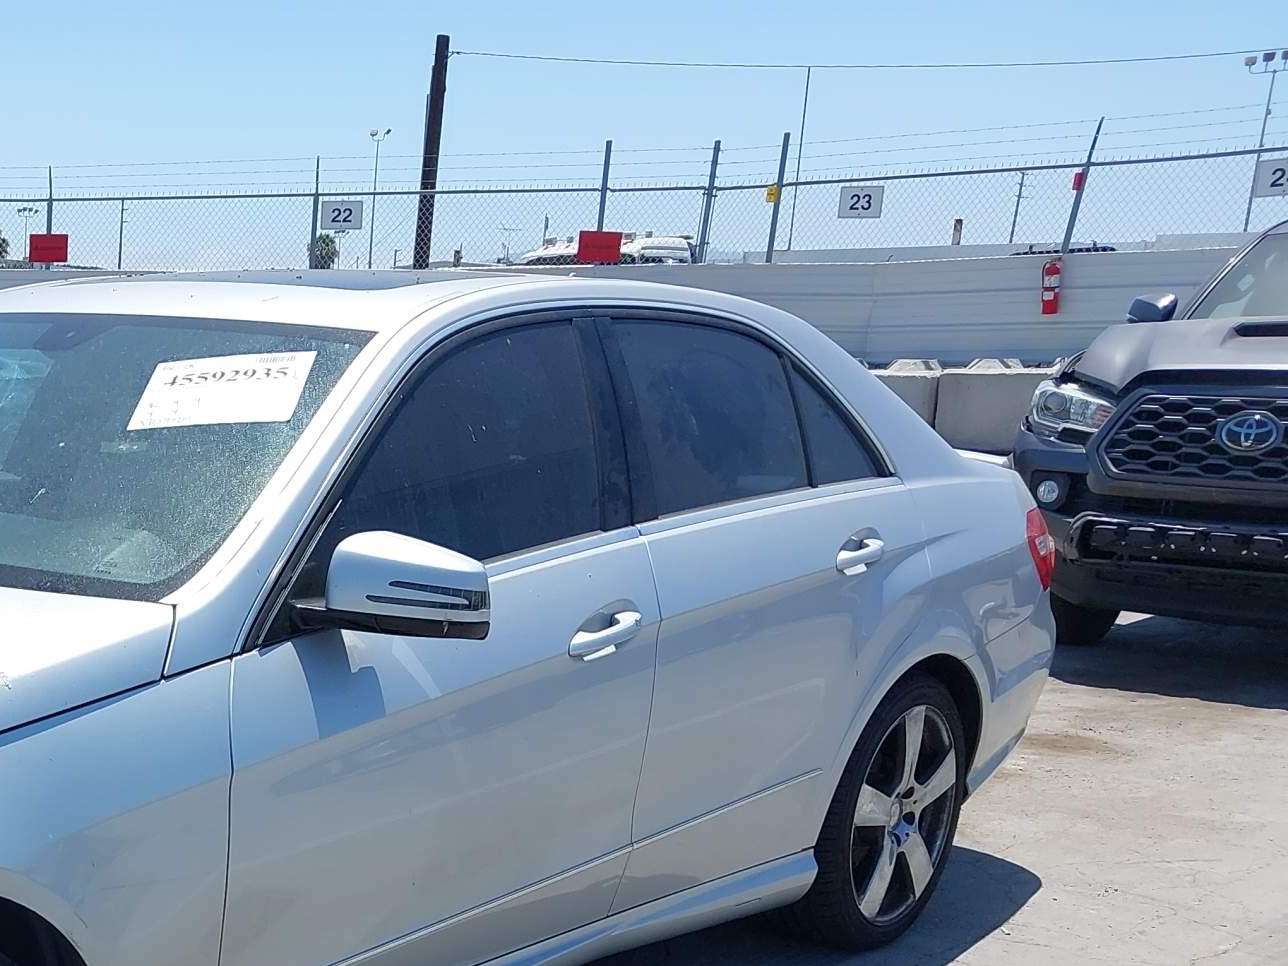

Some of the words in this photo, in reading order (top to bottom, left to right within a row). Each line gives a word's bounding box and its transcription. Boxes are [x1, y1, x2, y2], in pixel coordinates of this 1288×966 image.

[1270, 167, 1288, 188] 2
[848, 193, 872, 211] 23
[331, 207, 353, 223] 22
[164, 366, 289, 388] 45592935
